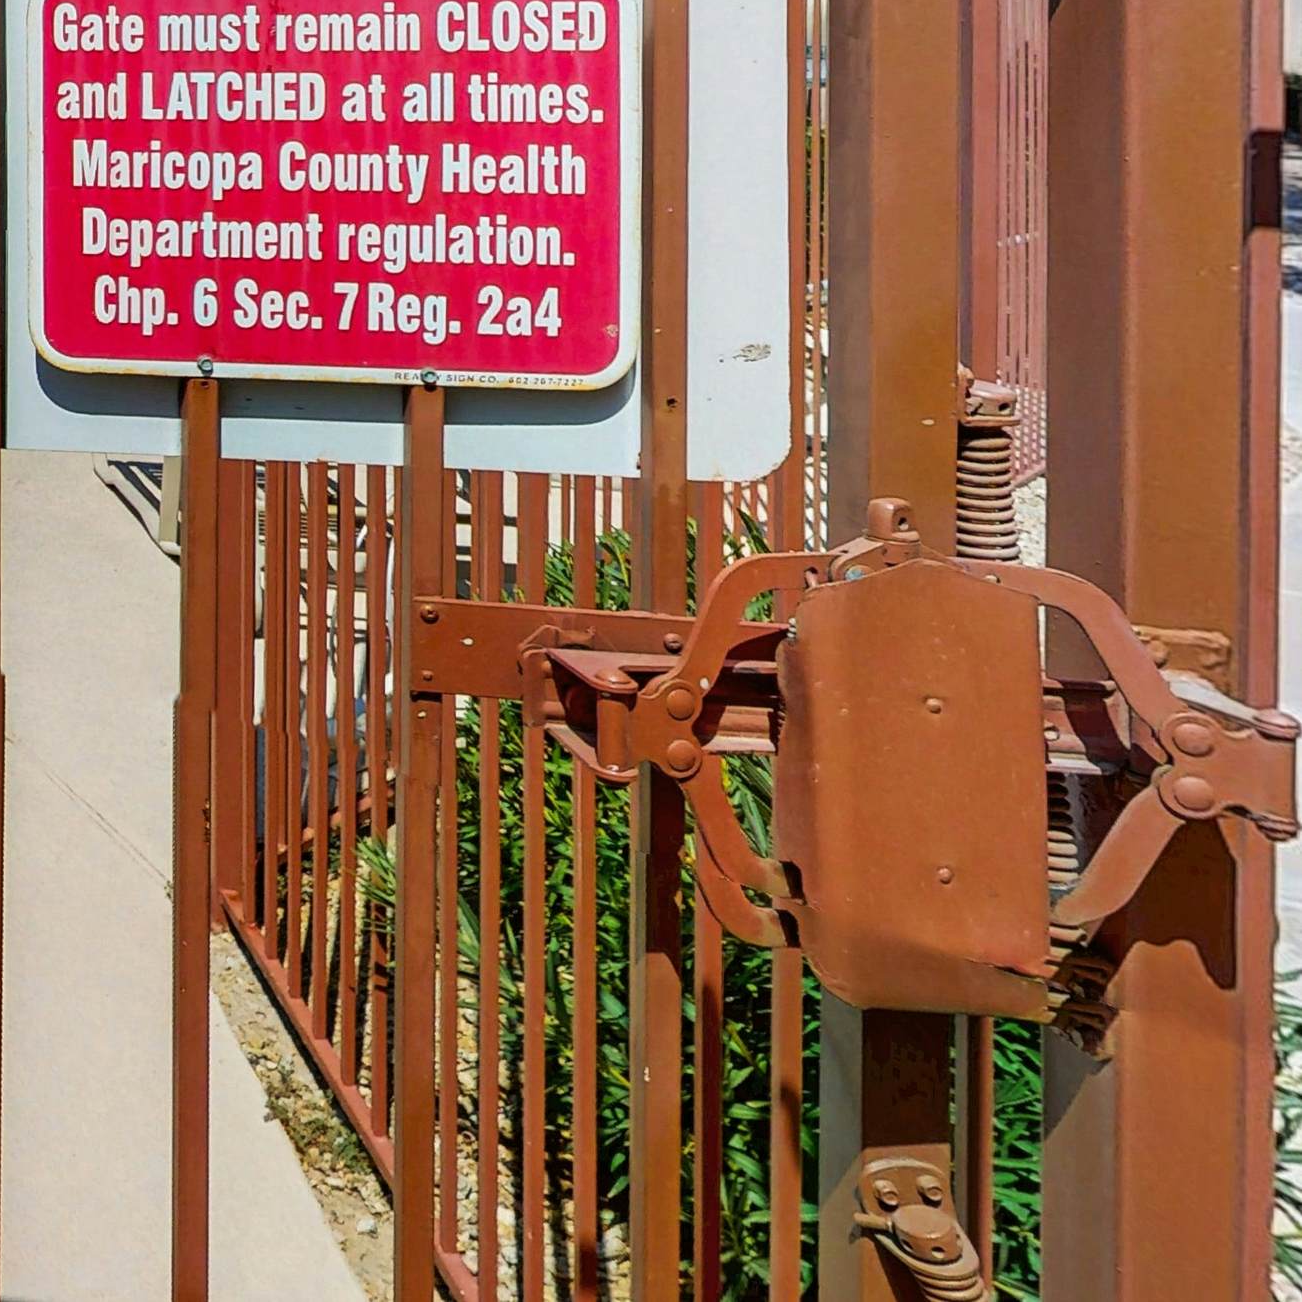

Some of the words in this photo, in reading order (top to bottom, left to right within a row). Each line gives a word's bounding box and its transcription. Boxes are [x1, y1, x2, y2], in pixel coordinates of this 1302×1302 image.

[54, 3, 143, 52] Gate
[159, 5, 260, 51] must
[276, 2, 420, 51] remain
[437, 0, 606, 52] CLOSED
[58, 73, 126, 119] and
[142, 71, 325, 121] LATCHED
[342, 75, 385, 121] at
[403, 73, 454, 121] all
[468, 72, 603, 123] times.
[73, 139, 262, 200] Maricopa
[279, 141, 428, 203] County
[442, 143, 585, 194] Health
[83, 208, 322, 267] Department
[339, 214, 574, 273] regulation.
[95, 275, 177, 335] Chp.
[194, 278, 217, 326] 6
[234, 279, 322, 329] Sec.
[335, 282, 358, 329] 7
[368, 283, 460, 344] Reg.
[478, 286, 561, 336] 2a4
[446, 374, 475, 382] SIGN
[479, 375, 500, 384] CO.
